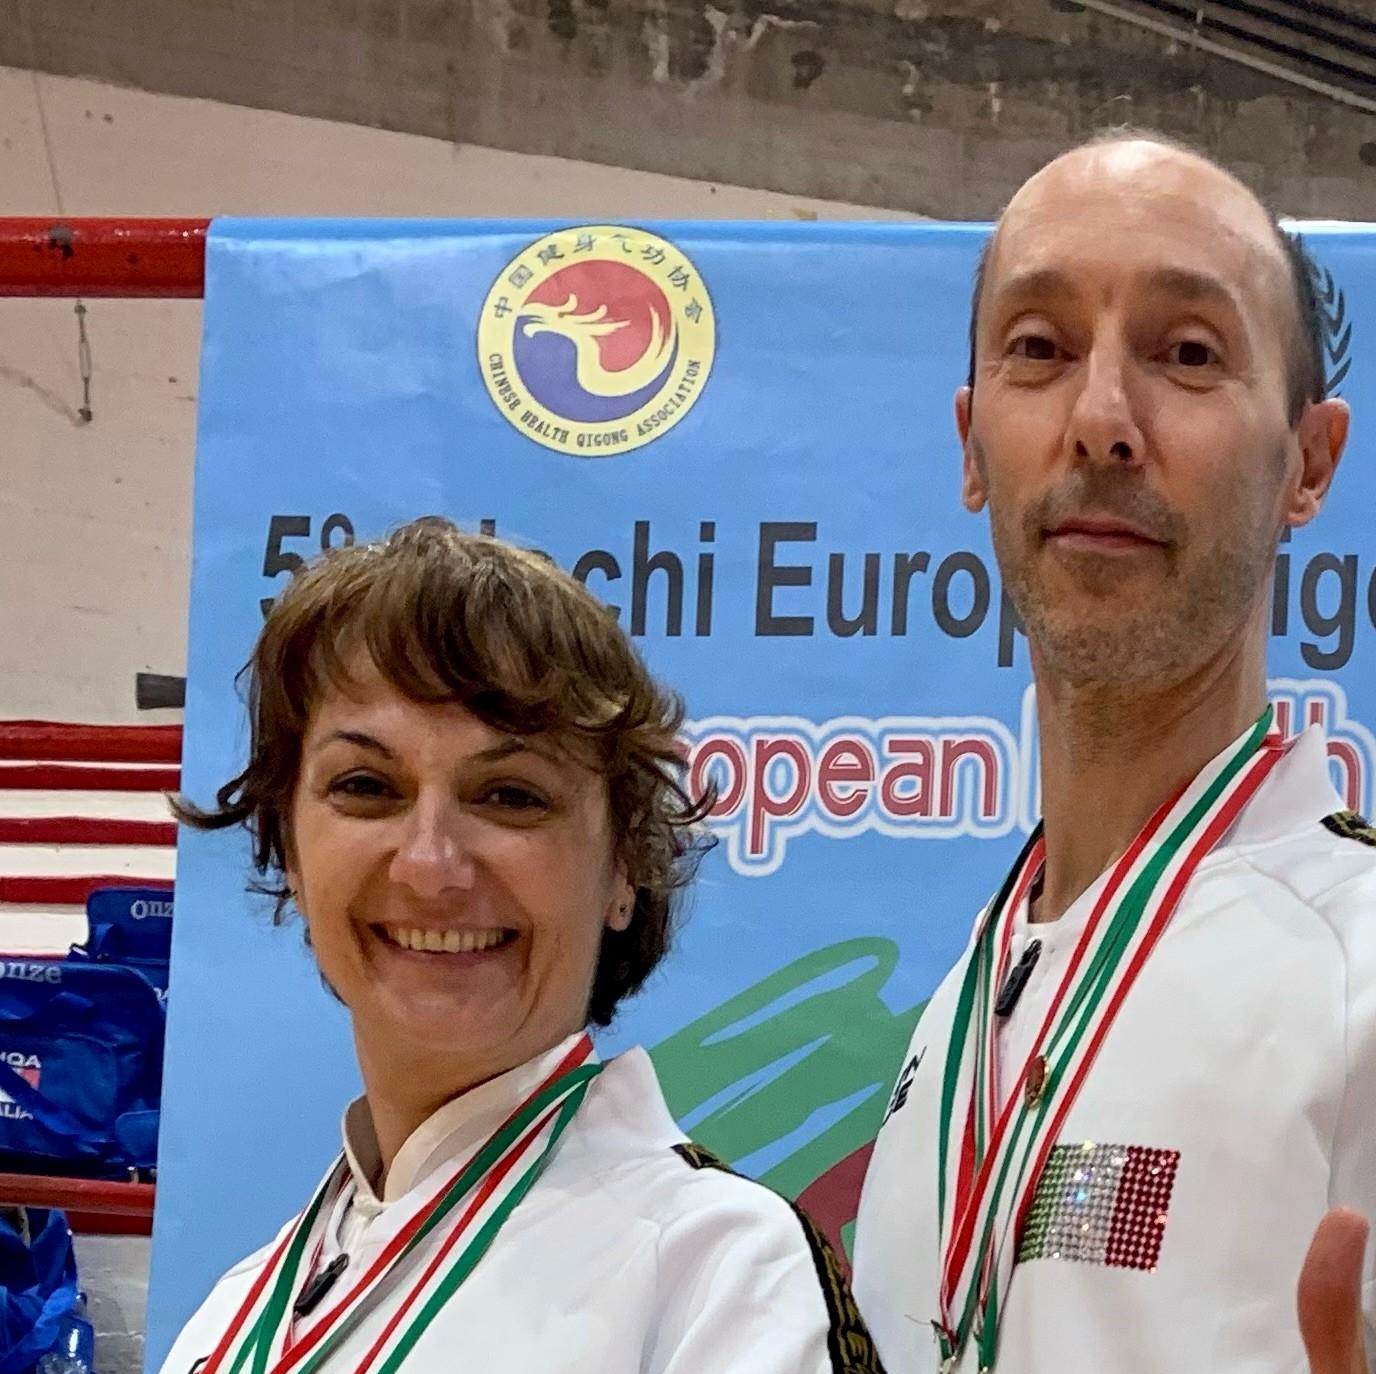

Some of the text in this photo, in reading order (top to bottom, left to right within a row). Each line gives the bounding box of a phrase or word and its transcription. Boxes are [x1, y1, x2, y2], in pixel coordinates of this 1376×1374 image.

[494, 233, 704, 325] 中国健身气功协会
[520, 410, 570, 444] HEALTH
[576, 431, 629, 448] QIGONG
[636, 359, 702, 437] ASSOCIATION
[755, 520, 1034, 668] Europ
[672, 738, 996, 855] opean
[130, 899, 174, 920] Onz
